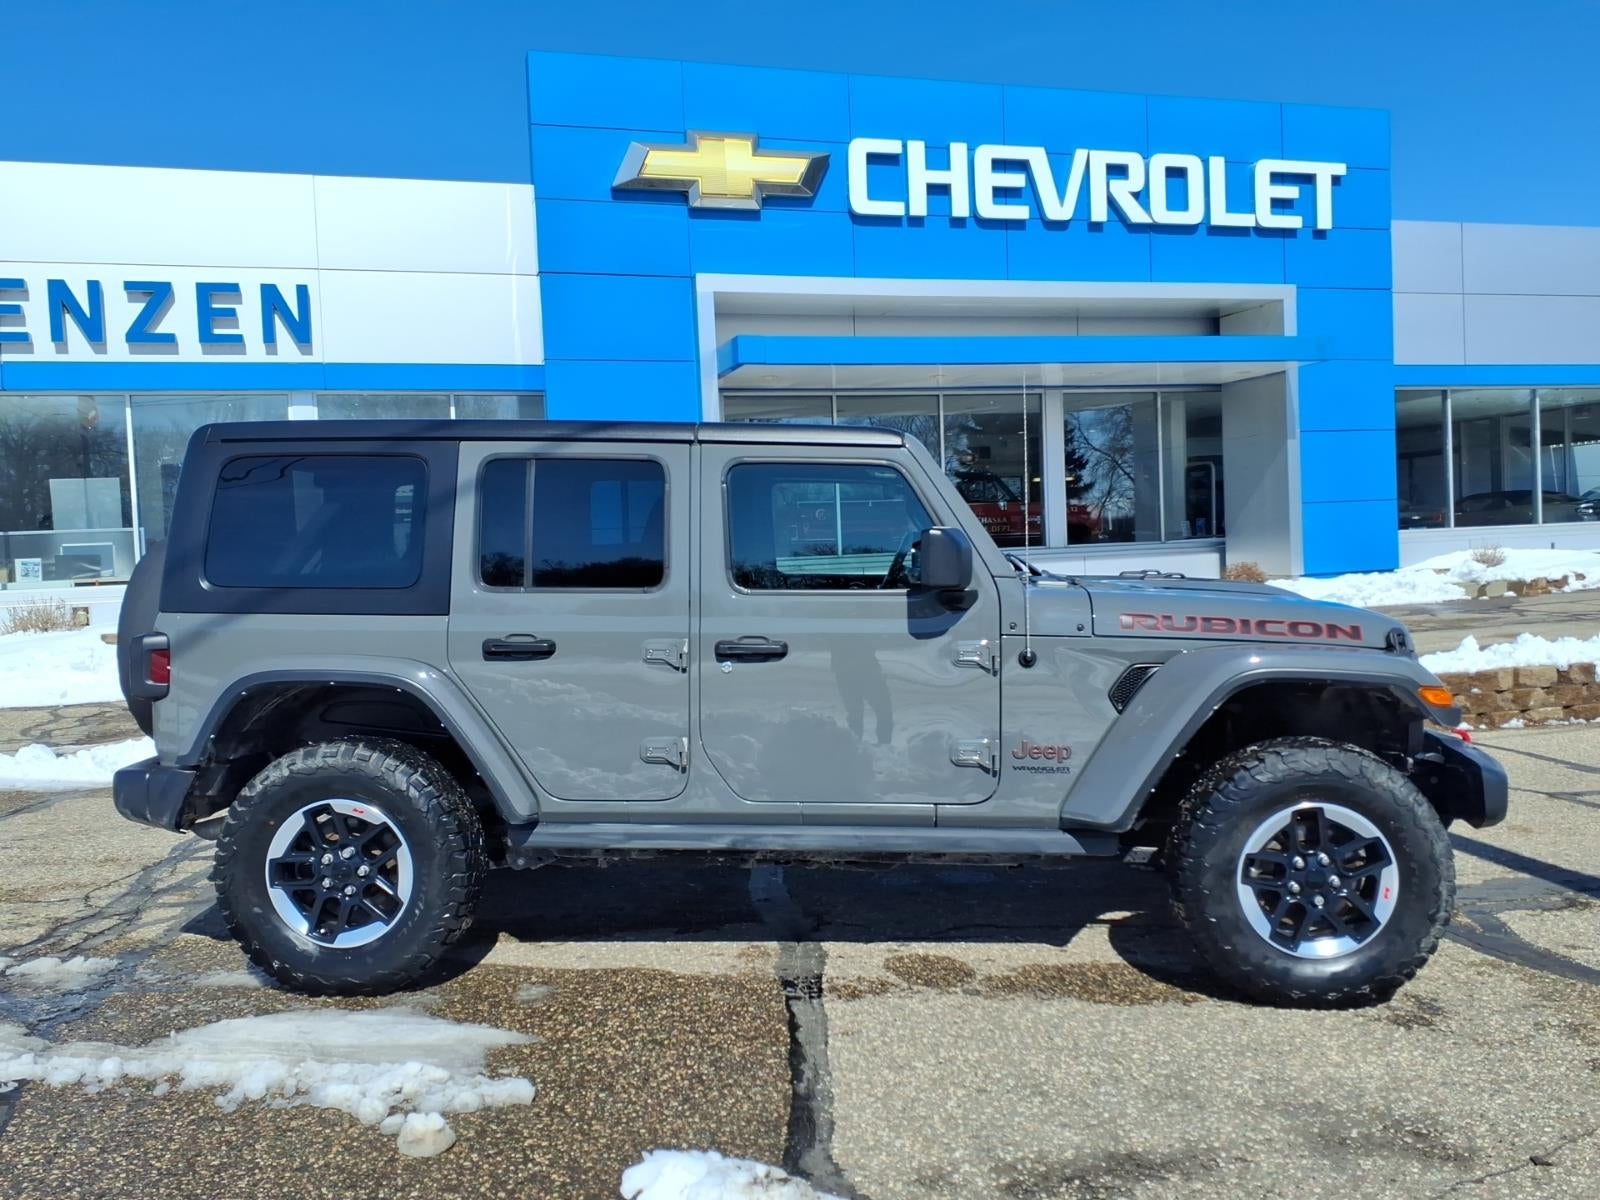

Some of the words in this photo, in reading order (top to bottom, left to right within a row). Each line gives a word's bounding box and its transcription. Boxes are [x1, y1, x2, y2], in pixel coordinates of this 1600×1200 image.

[848, 137, 1346, 230] CHEVROLET
[1120, 613, 1362, 641] RUBICON
[1012, 740, 1072, 763] Jeep
